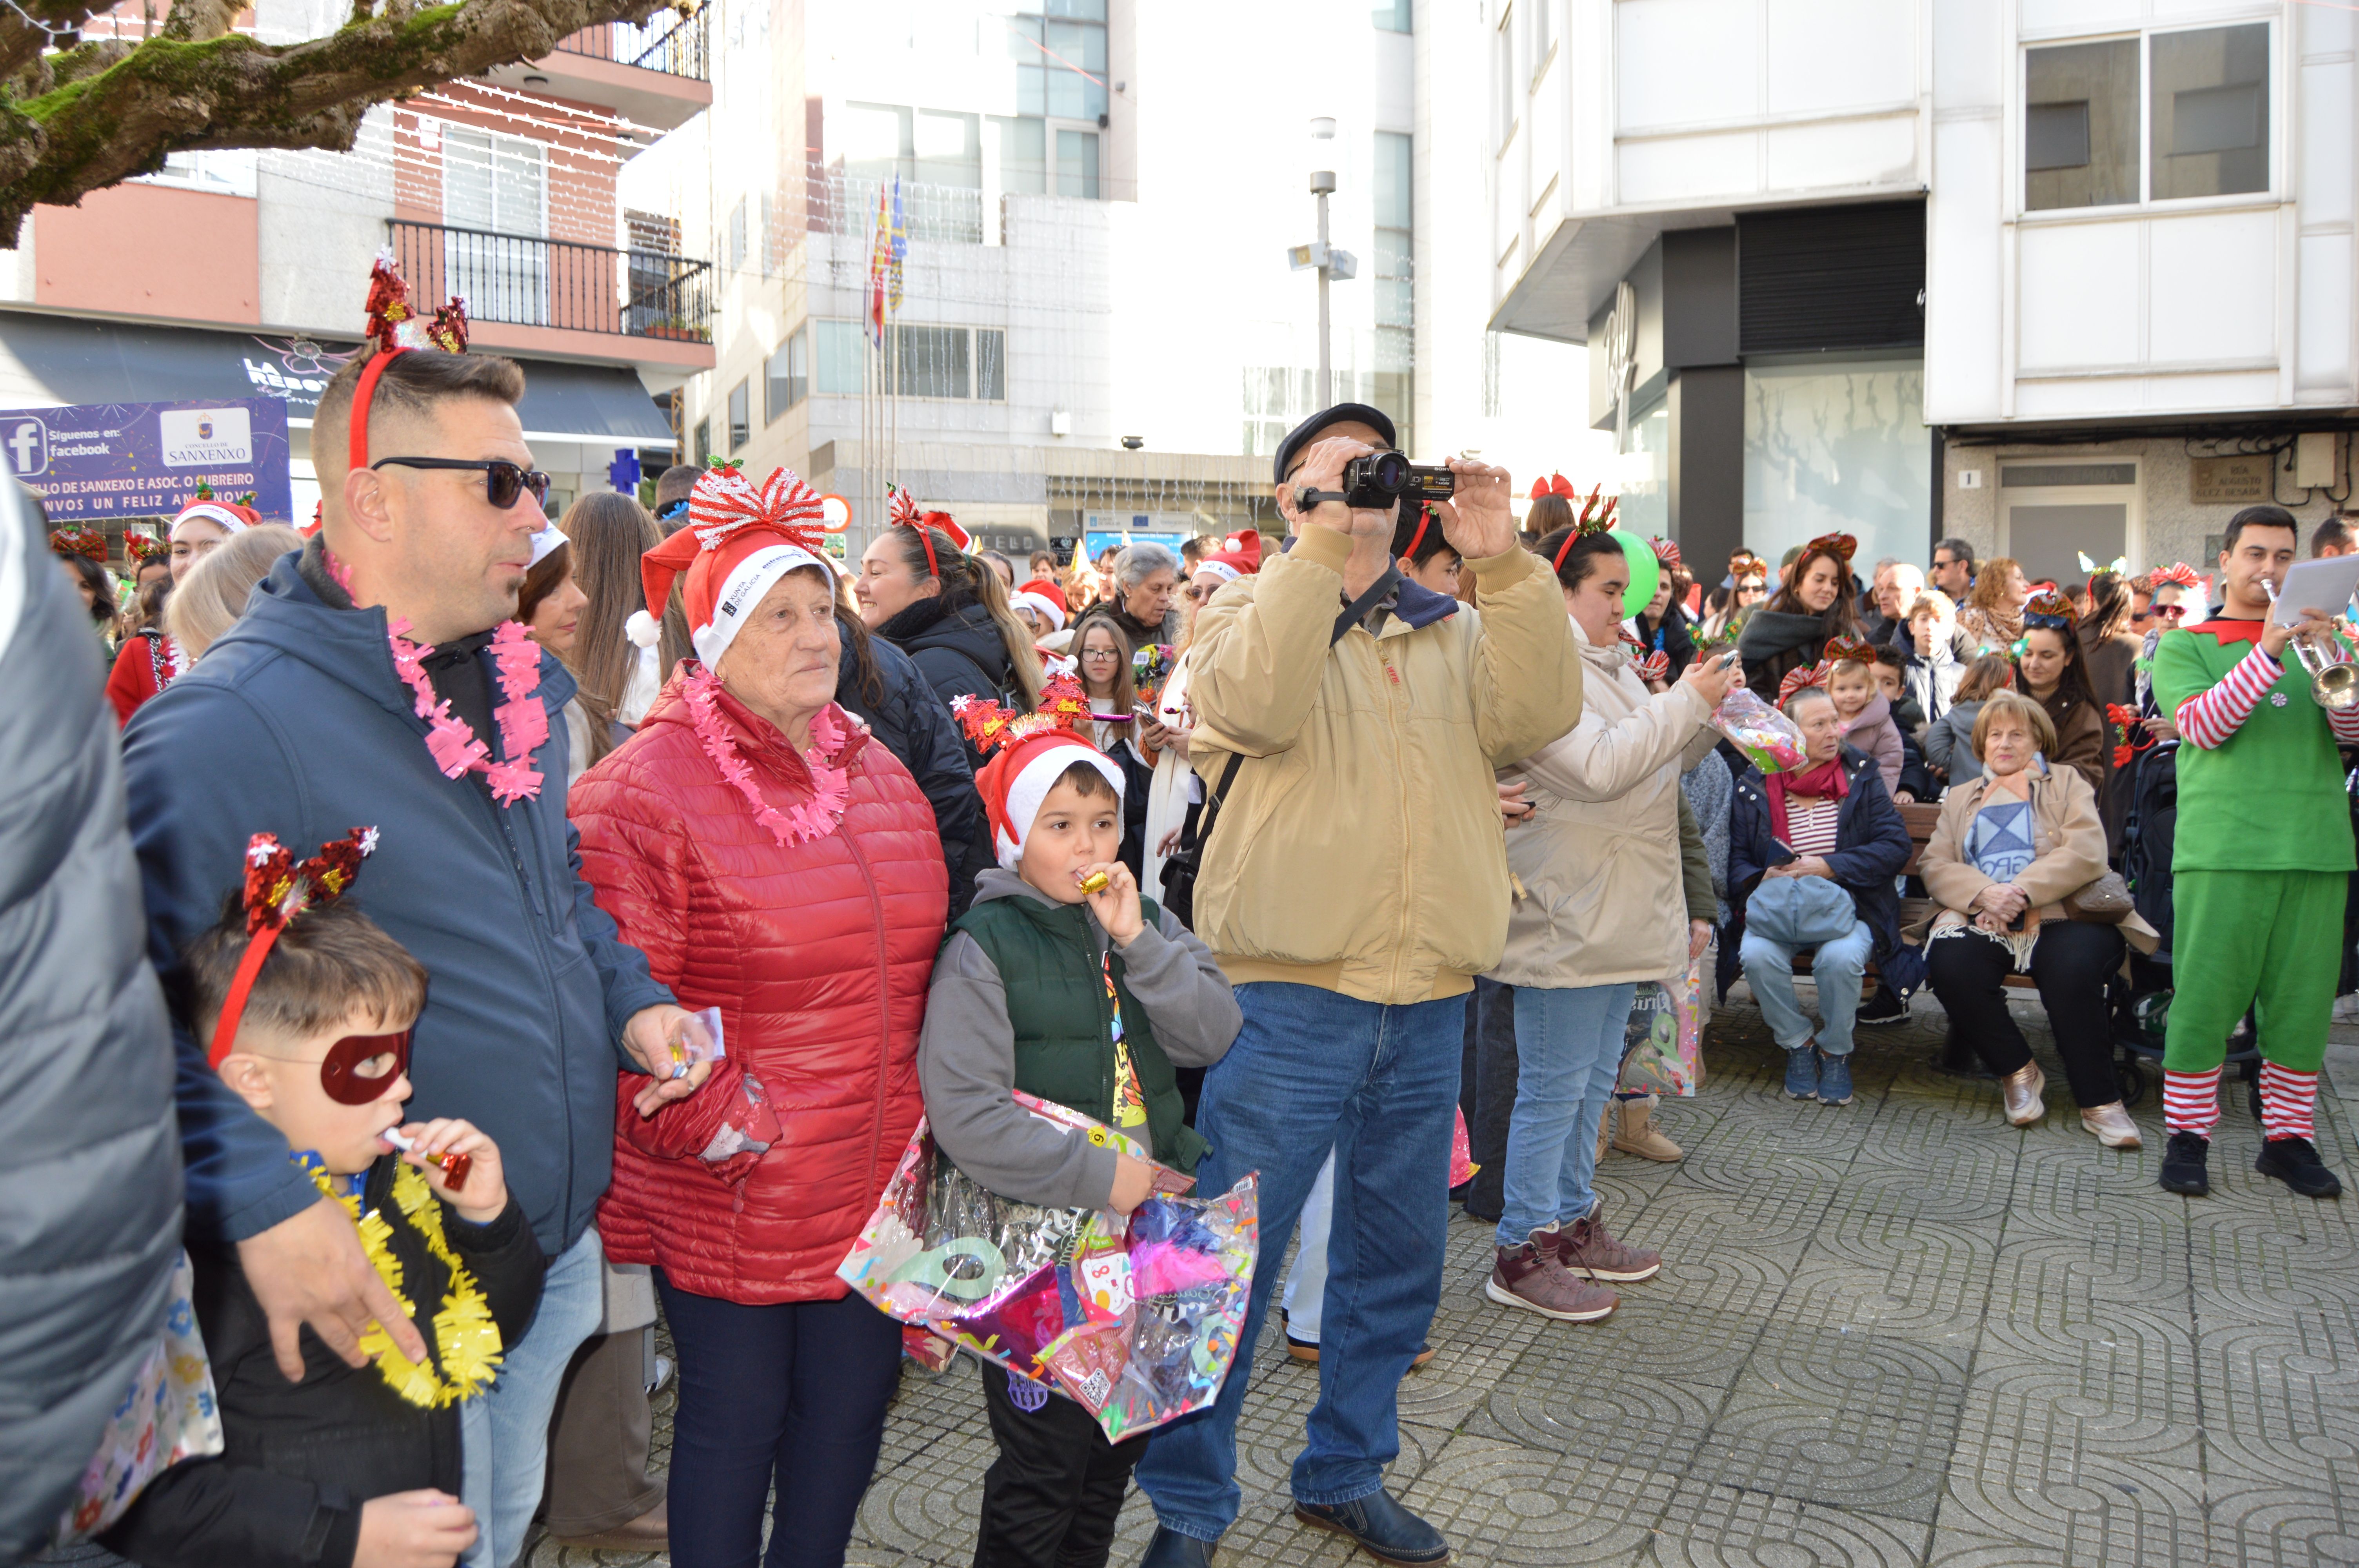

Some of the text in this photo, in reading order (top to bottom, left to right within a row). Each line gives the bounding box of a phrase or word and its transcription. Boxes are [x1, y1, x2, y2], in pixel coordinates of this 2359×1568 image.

[49, 430, 99, 442] Síguenos
[50, 443, 110, 457] facebook
[169, 448, 245, 463] SANXENXO
[62, 482, 78, 494] DE
[81, 479, 135, 493] SANXEXO
[138, 478, 145, 490] E
[147, 476, 182, 489] ASOC.
[184, 475, 194, 487] O
[2219, 475, 2262, 486] AUGUSTO
[2225, 487, 2261, 496] BESADA
[93, 497, 113, 510] UN
[123, 495, 163, 508] FELIZ
[729, 581, 747, 602] XUNTA
[734, 574, 761, 606] DE GALICIA
[1093, 1133, 1104, 1143] 6
